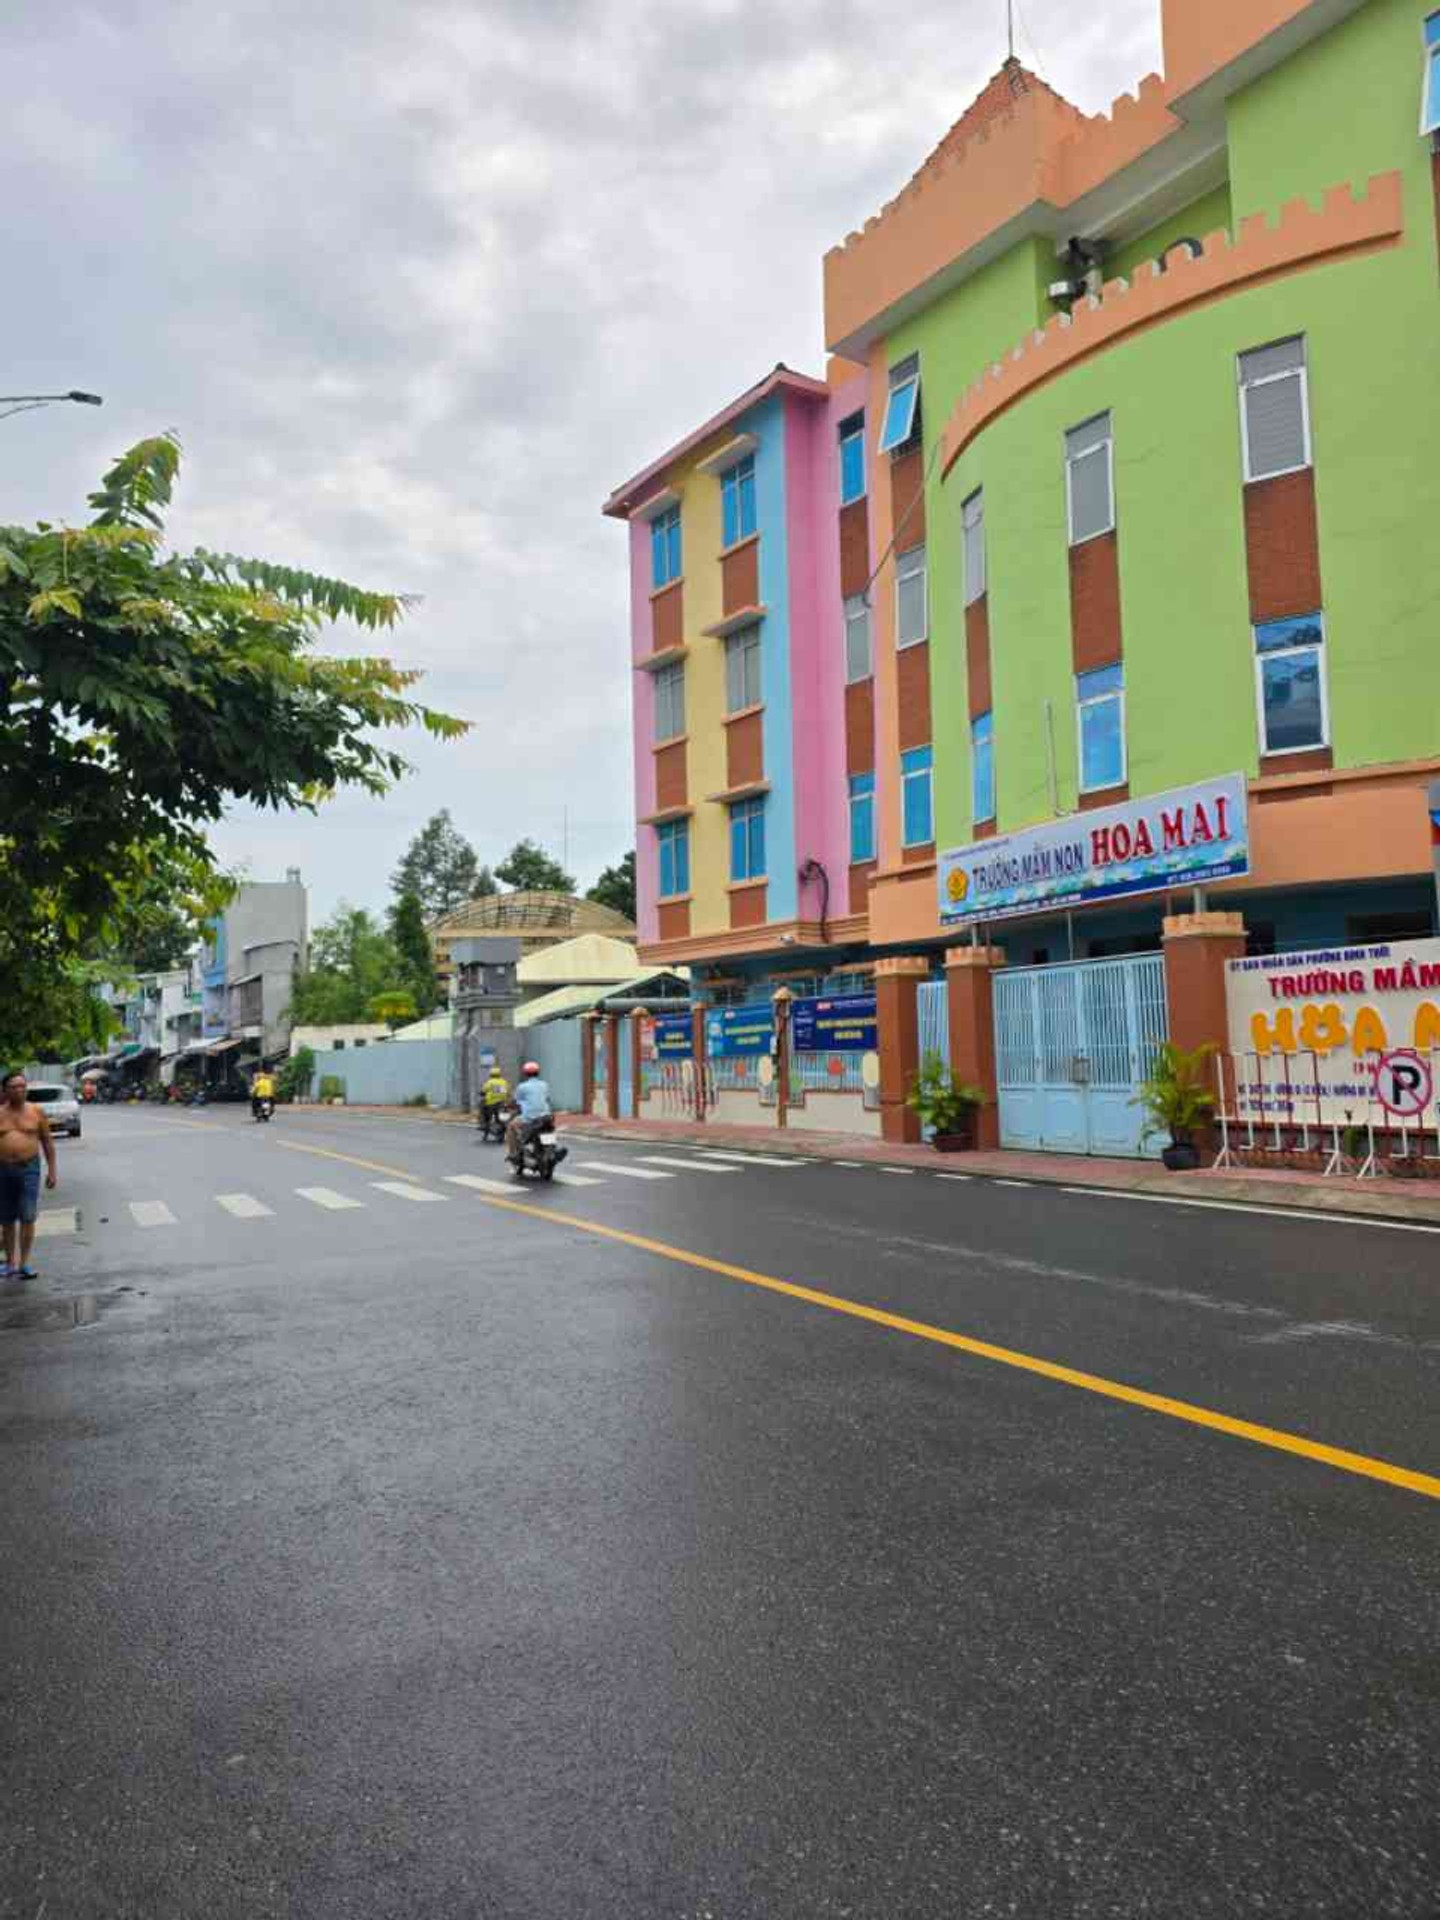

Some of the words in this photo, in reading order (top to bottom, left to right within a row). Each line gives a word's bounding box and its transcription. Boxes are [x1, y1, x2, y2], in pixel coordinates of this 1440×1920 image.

[1090, 817, 1154, 866] HOA
[1161, 796, 1229, 852] MAI
[1268, 967, 1367, 999] TRƯỜNG
[1250, 1002, 1388, 1058] HOA
